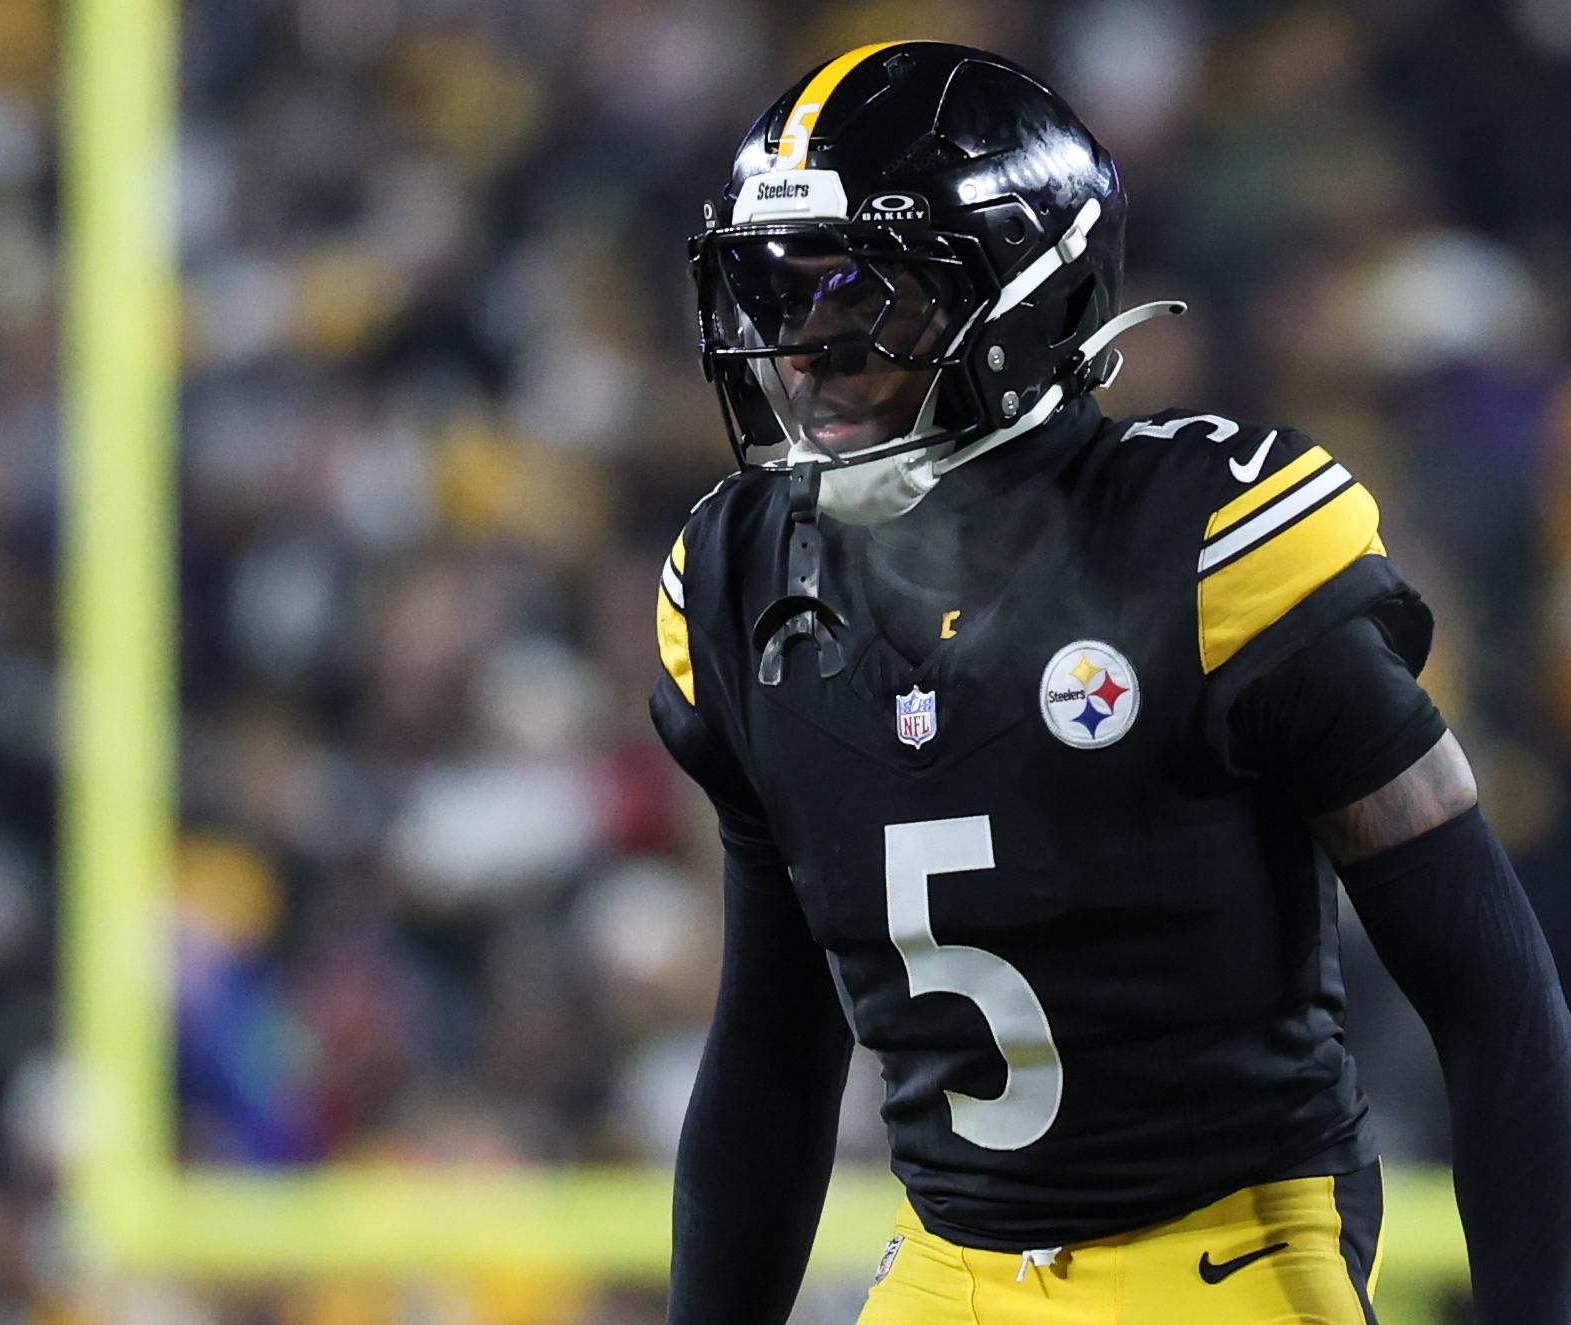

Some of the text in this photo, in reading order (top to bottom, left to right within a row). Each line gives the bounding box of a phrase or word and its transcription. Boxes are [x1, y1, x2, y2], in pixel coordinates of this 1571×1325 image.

[777, 103, 821, 169] 5
[757, 179, 809, 200] Steelers
[862, 211, 925, 221] OAKLEY
[1048, 689, 1086, 703] Steelers
[903, 716, 929, 737] NFL
[885, 815, 1063, 1151] 5
